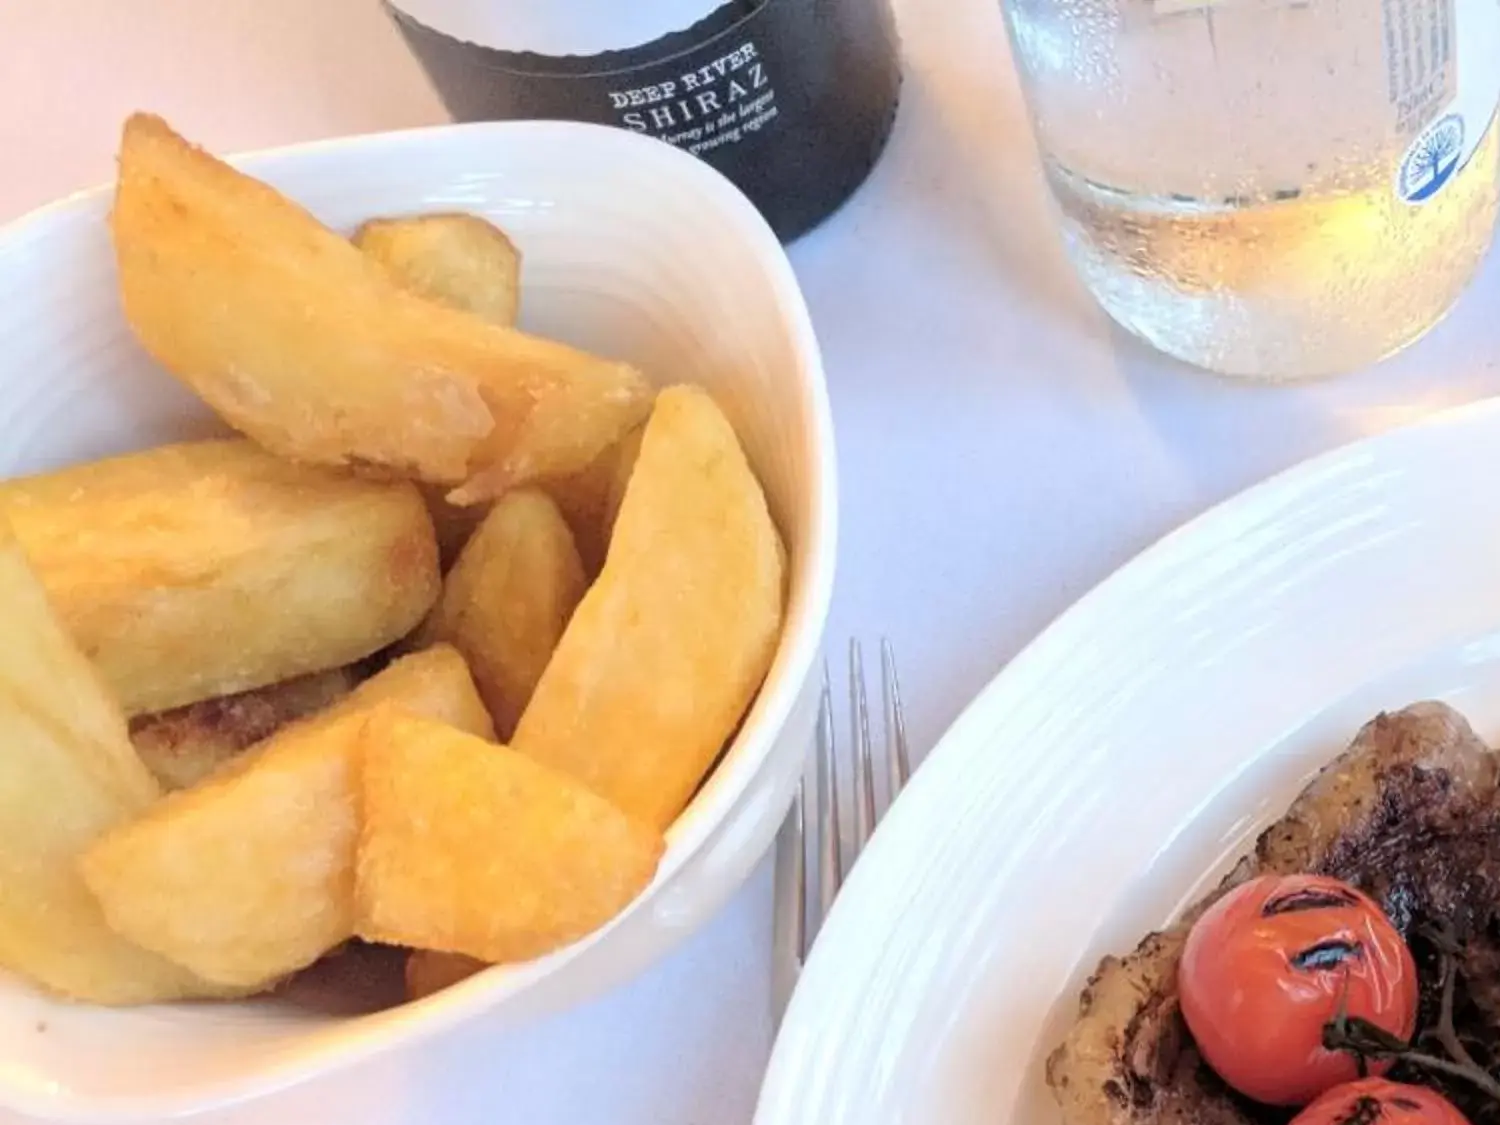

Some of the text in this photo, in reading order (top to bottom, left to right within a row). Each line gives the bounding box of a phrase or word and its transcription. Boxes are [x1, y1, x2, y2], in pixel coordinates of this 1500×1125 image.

[609, 42, 758, 109] DEEP RIVER
[623, 64, 768, 132] SHIRAZ
